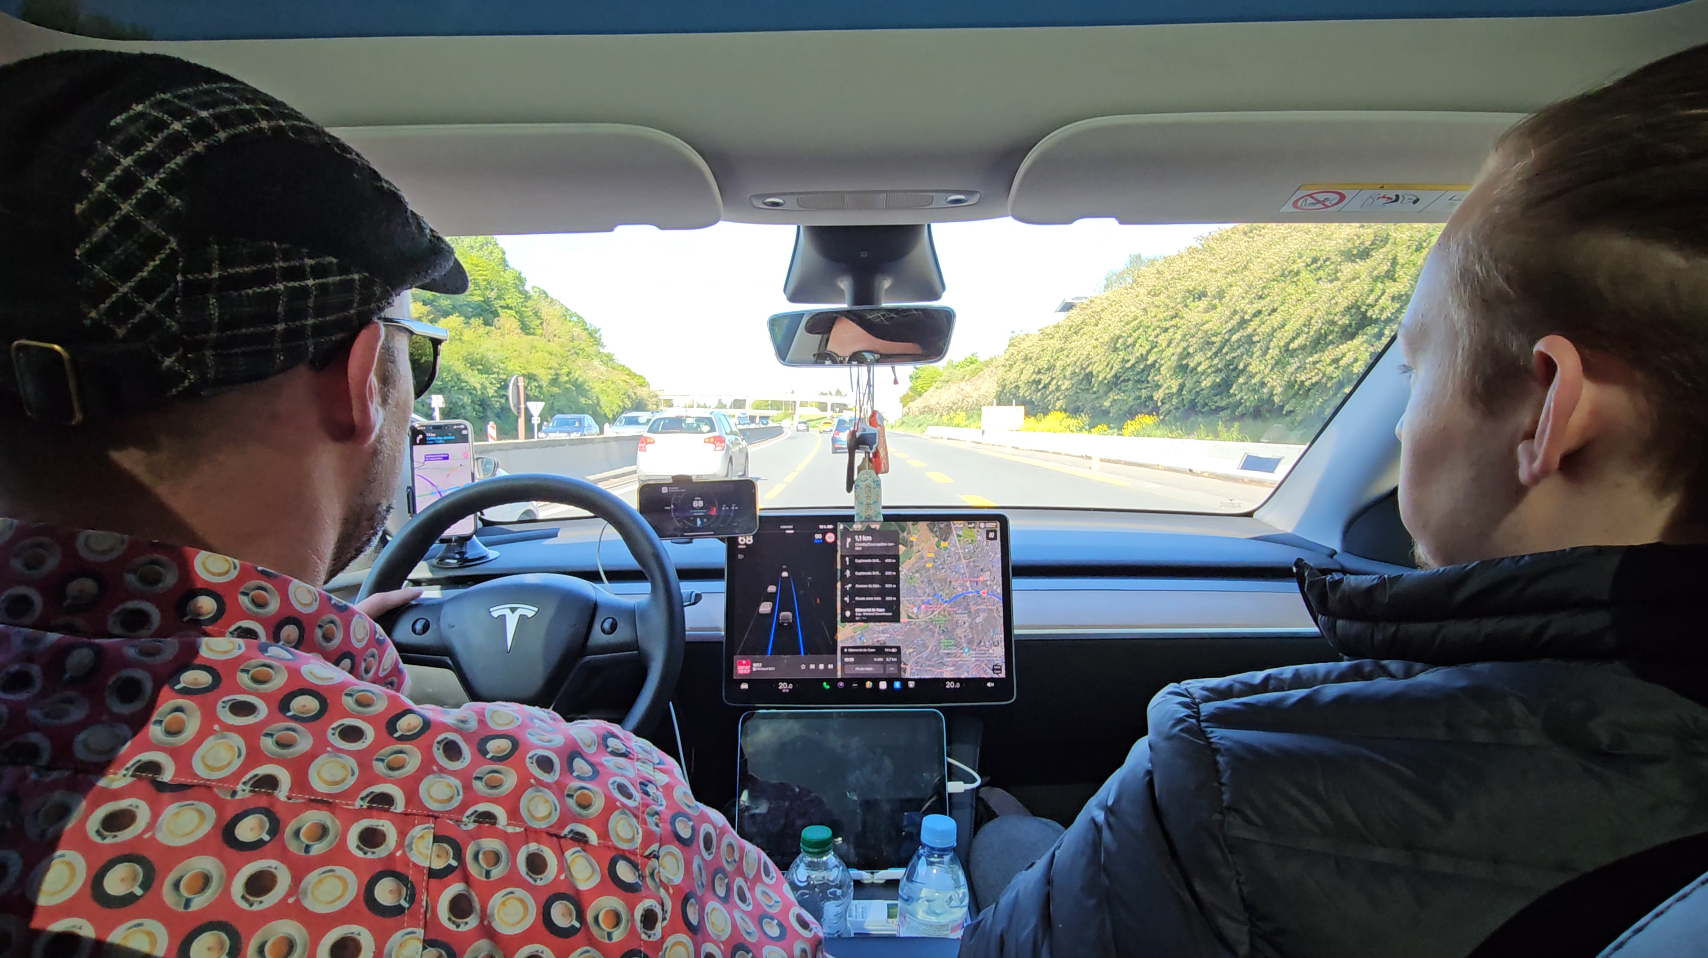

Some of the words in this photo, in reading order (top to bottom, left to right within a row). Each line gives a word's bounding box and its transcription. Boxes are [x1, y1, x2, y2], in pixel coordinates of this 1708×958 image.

[738, 536, 754, 545] 68
[778, 682, 793, 690] 20.0
[945, 681, 960, 689] 20.0
